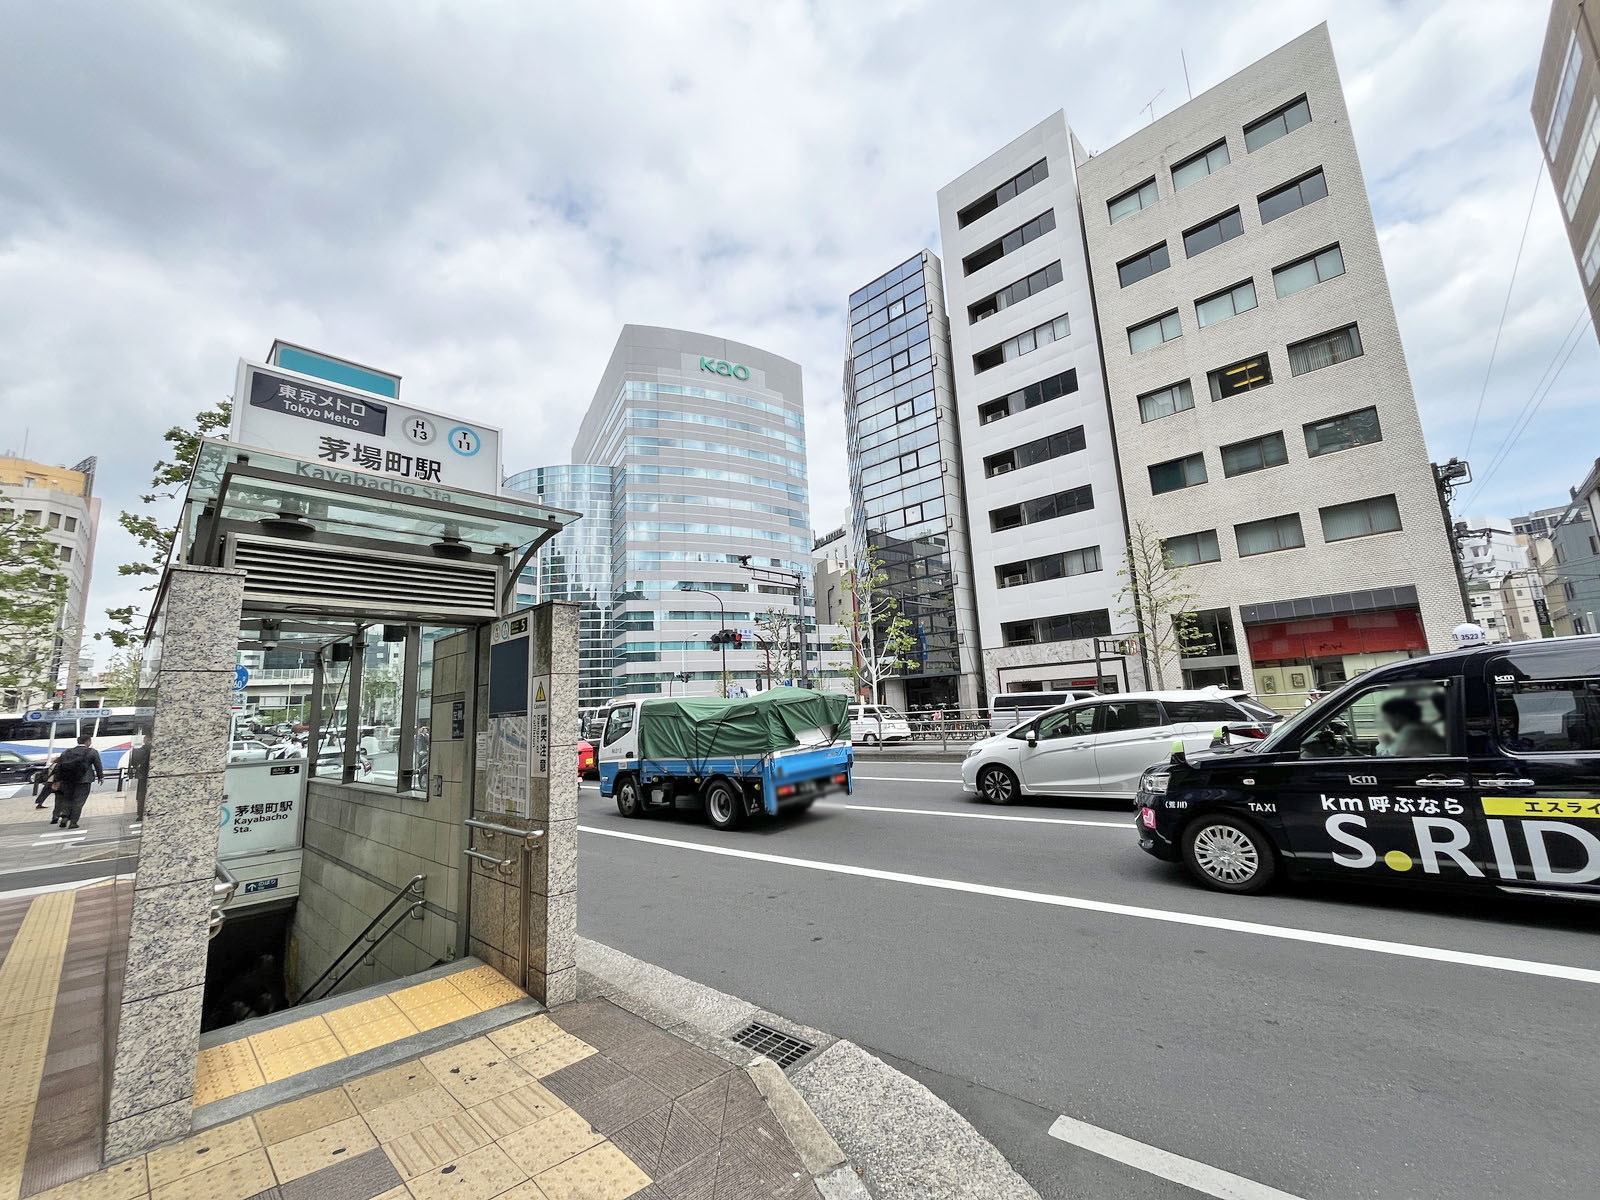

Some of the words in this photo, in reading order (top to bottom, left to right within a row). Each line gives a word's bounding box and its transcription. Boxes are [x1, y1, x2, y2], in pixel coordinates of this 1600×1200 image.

[278, 383, 366, 417] 東京メトロ
[283, 399, 321, 418] Tokyo
[323, 410, 360, 426] Metro
[415, 420, 425, 429] H
[412, 428, 428, 440] 13
[461, 431, 469, 440] T
[457, 440, 471, 450] 11
[318, 435, 442, 483] 茅場町駅
[295, 460, 415, 497] Kayabacho
[520, 619, 526, 631] 5
[289, 766, 295, 774] 5
[1348, 774, 1378, 785] km
[234, 800, 293, 817] 茅場町駅
[1248, 802, 1277, 813] TAXI
[234, 812, 288, 826] Kayabacho
[233, 826, 252, 834] Sta.
